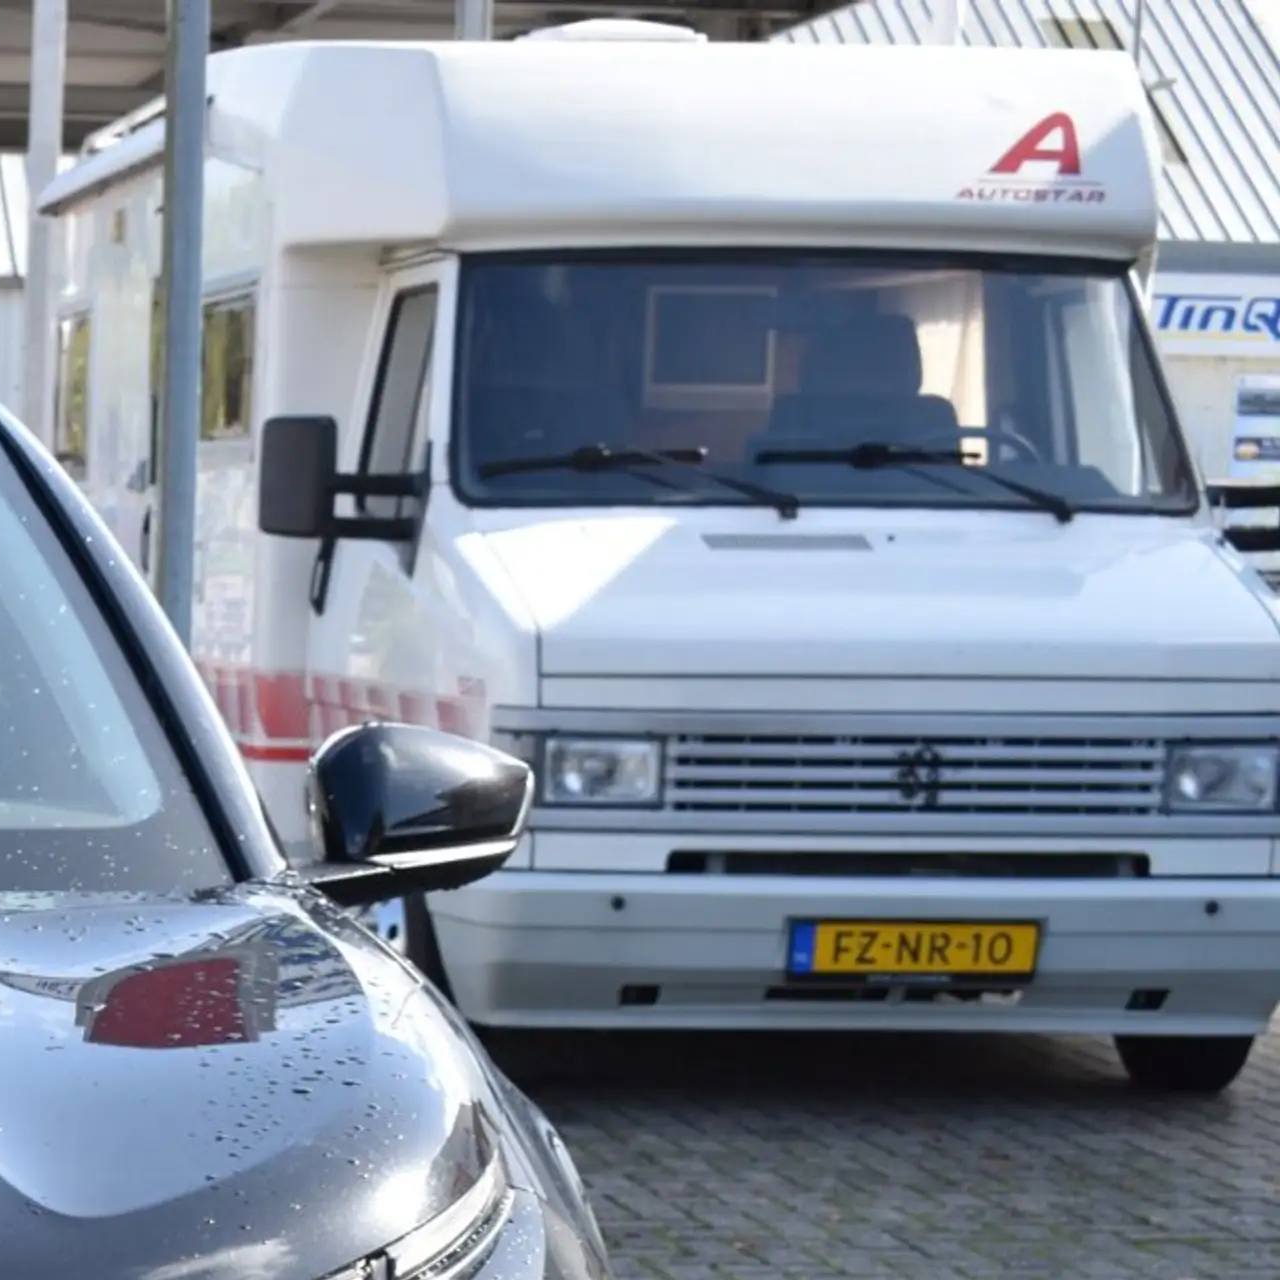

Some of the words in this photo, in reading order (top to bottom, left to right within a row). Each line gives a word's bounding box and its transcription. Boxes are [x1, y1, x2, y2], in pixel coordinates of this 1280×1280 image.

[988, 111, 1082, 176] A
[954, 186, 1107, 204] AUTOSTAR
[831, 931, 1015, 966] FZ-NR-10
